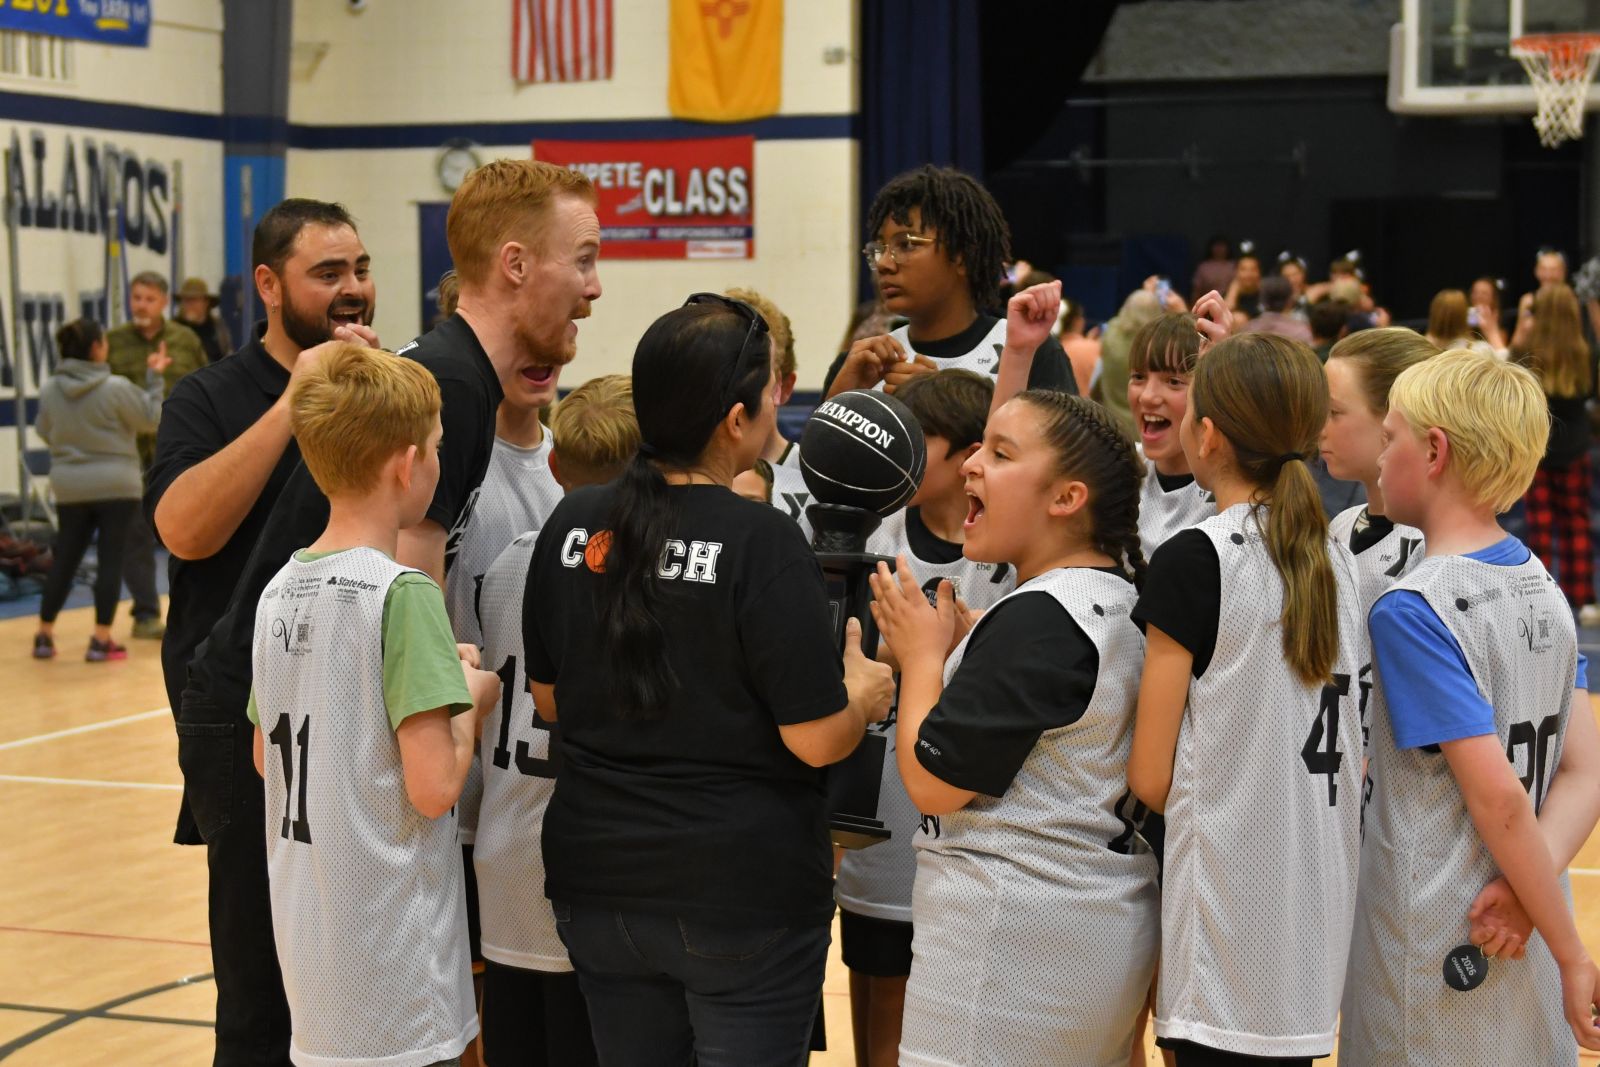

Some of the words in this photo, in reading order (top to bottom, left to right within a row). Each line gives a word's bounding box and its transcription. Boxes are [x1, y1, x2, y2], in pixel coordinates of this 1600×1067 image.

[643, 166, 749, 216] CLASS
[976, 562, 992, 571] the
[1301, 673, 1351, 807] 4
[268, 712, 312, 845] 11
[1460, 955, 1477, 976] 2026
